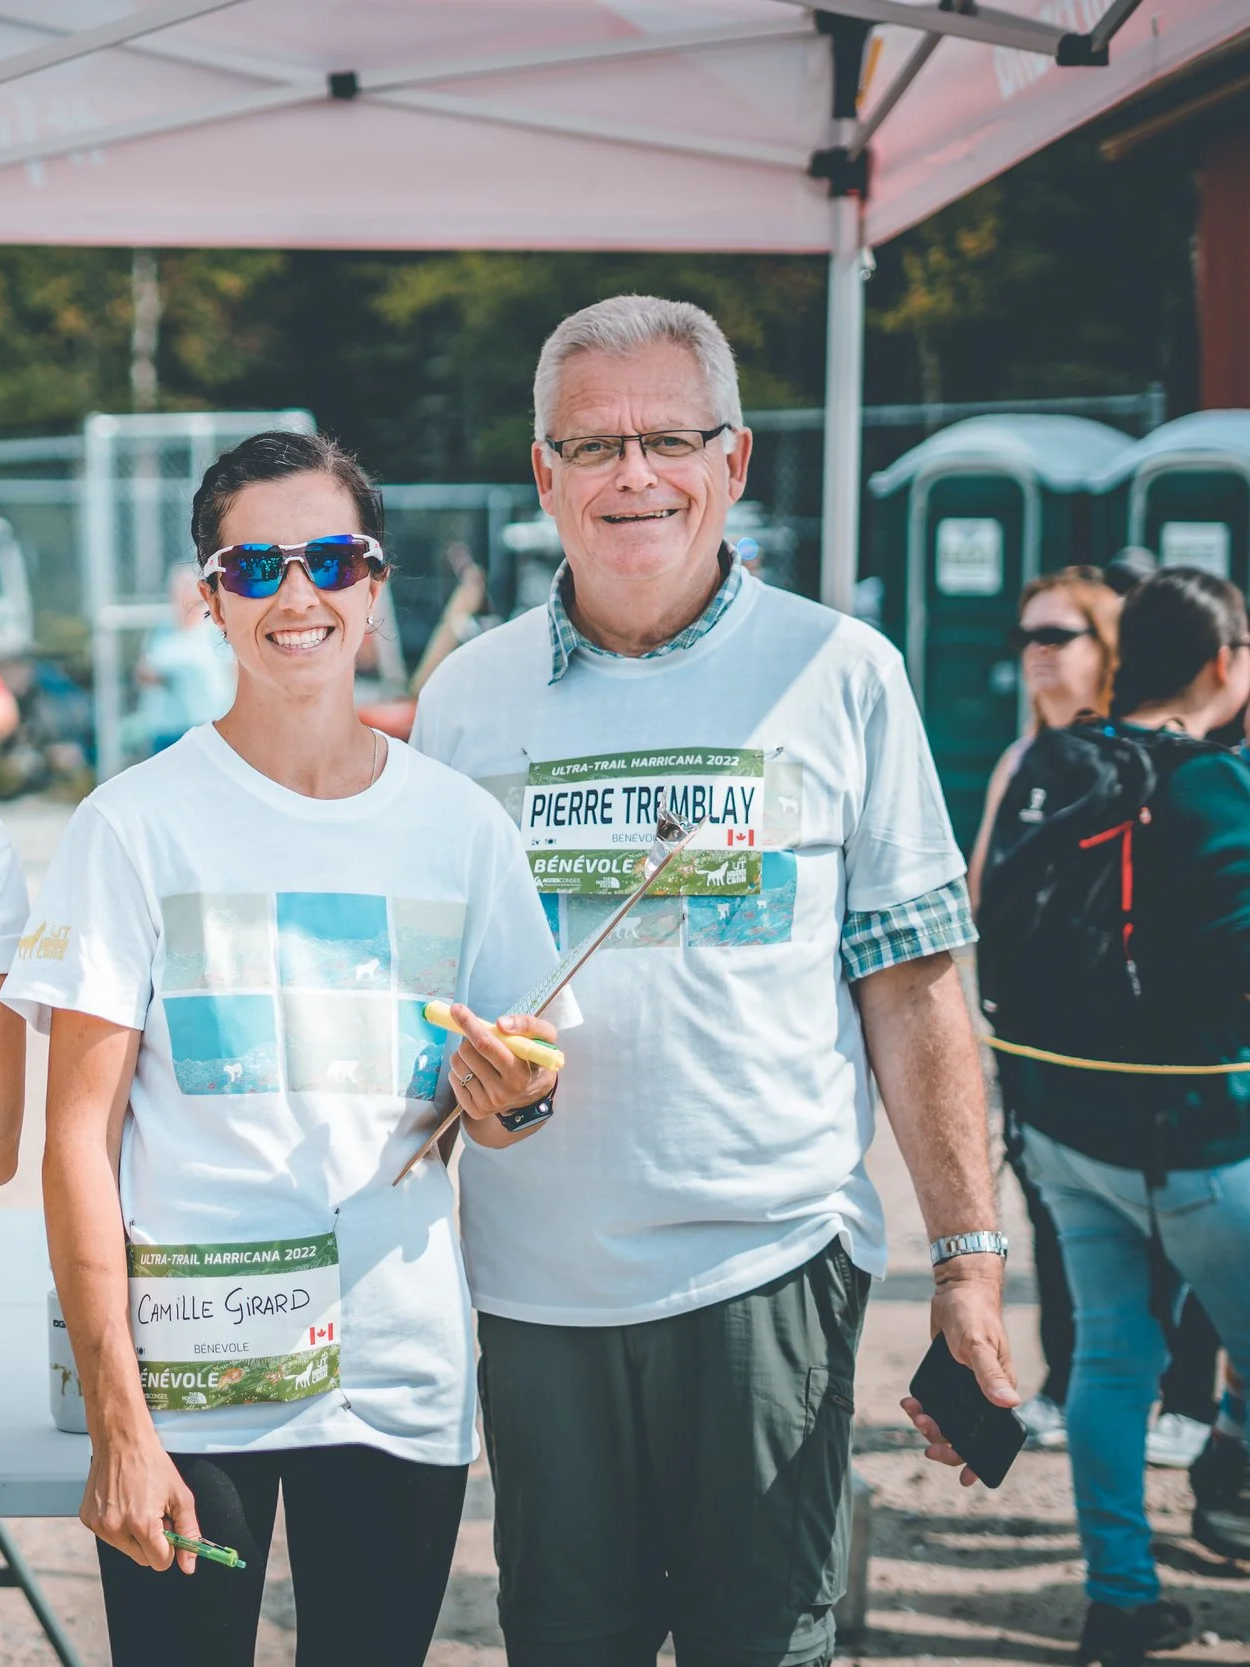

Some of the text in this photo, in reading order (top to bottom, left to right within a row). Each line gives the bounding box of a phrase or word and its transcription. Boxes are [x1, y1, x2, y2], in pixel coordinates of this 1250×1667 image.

[551, 754, 740, 776] ULTRA-TRAIL HARRICANA 2022
[530, 787, 615, 827] PIERRE
[534, 855, 635, 874] BÉNÉVOLE
[140, 1246, 317, 1265] ULTRA-TRAIL HARRICANA 2022
[141, 1368, 220, 1388] ÉNÉVOLE
